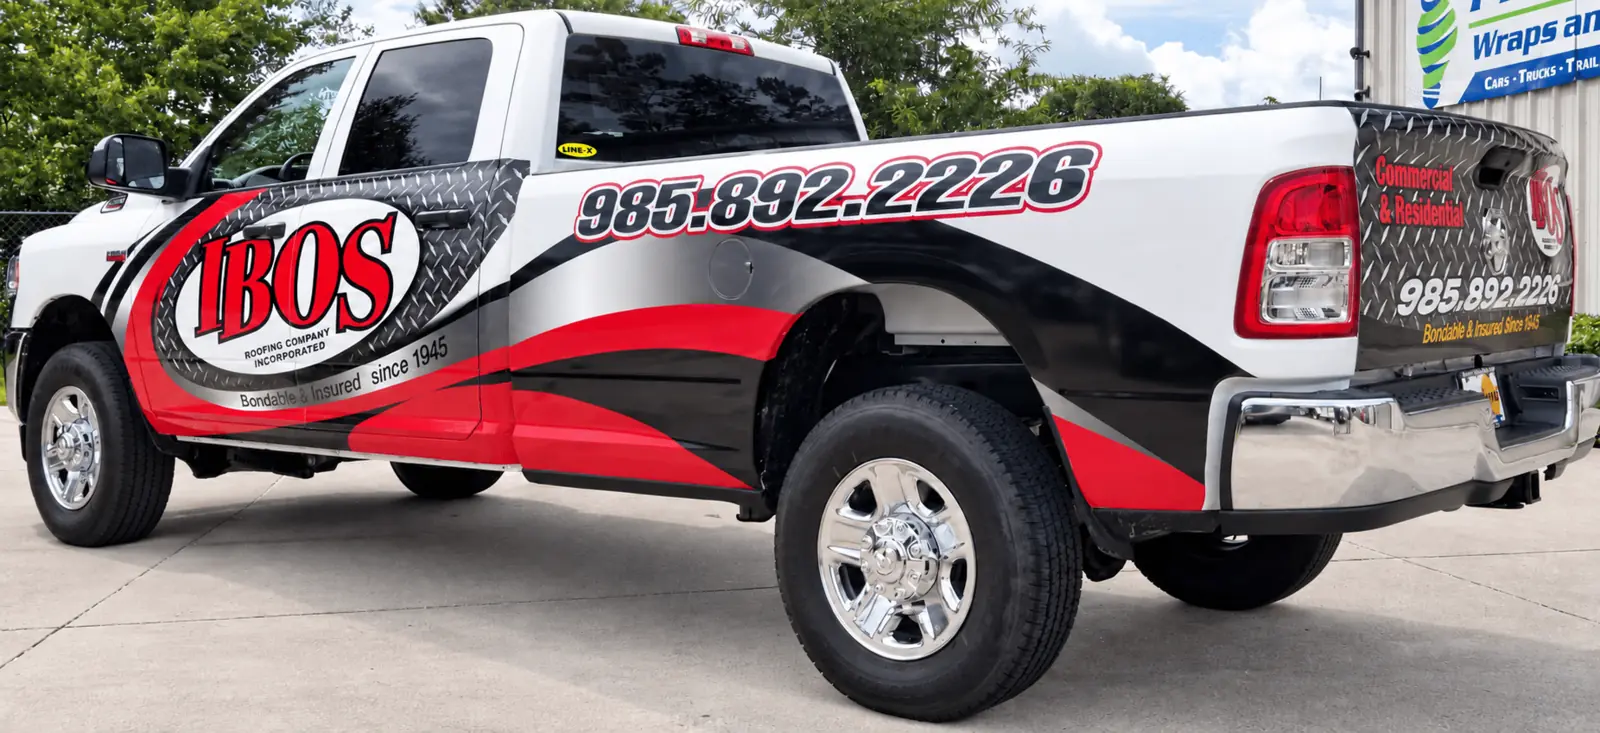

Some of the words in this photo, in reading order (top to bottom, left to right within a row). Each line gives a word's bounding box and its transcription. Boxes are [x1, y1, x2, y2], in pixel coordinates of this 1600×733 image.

[1473, 20, 1558, 61] Wraps
[561, 146, 593, 154] LINE-X
[574, 140, 1103, 243] 985.892.2226
[1375, 154, 1454, 192] Commercial
[1379, 194, 1392, 224] &
[1395, 195, 1464, 227] Residential
[194, 211, 398, 344] IBOS
[1398, 274, 1561, 316] 985.892.2226
[244, 341, 283, 360] ROOFING
[285, 328, 330, 347] COMPANY
[1422, 321, 1465, 344] Bondable
[1466, 319, 1473, 338] &
[1474, 319, 1503, 337] Insured
[1504, 316, 1523, 334] Since
[1524, 314, 1540, 331] 1945
[240, 390, 297, 408] Bondable
[299, 389, 308, 404] &
[311, 373, 361, 399] Insured
[371, 359, 409, 385] since
[412, 336, 448, 368] 1945
[254, 341, 326, 368] INCORPORATED
